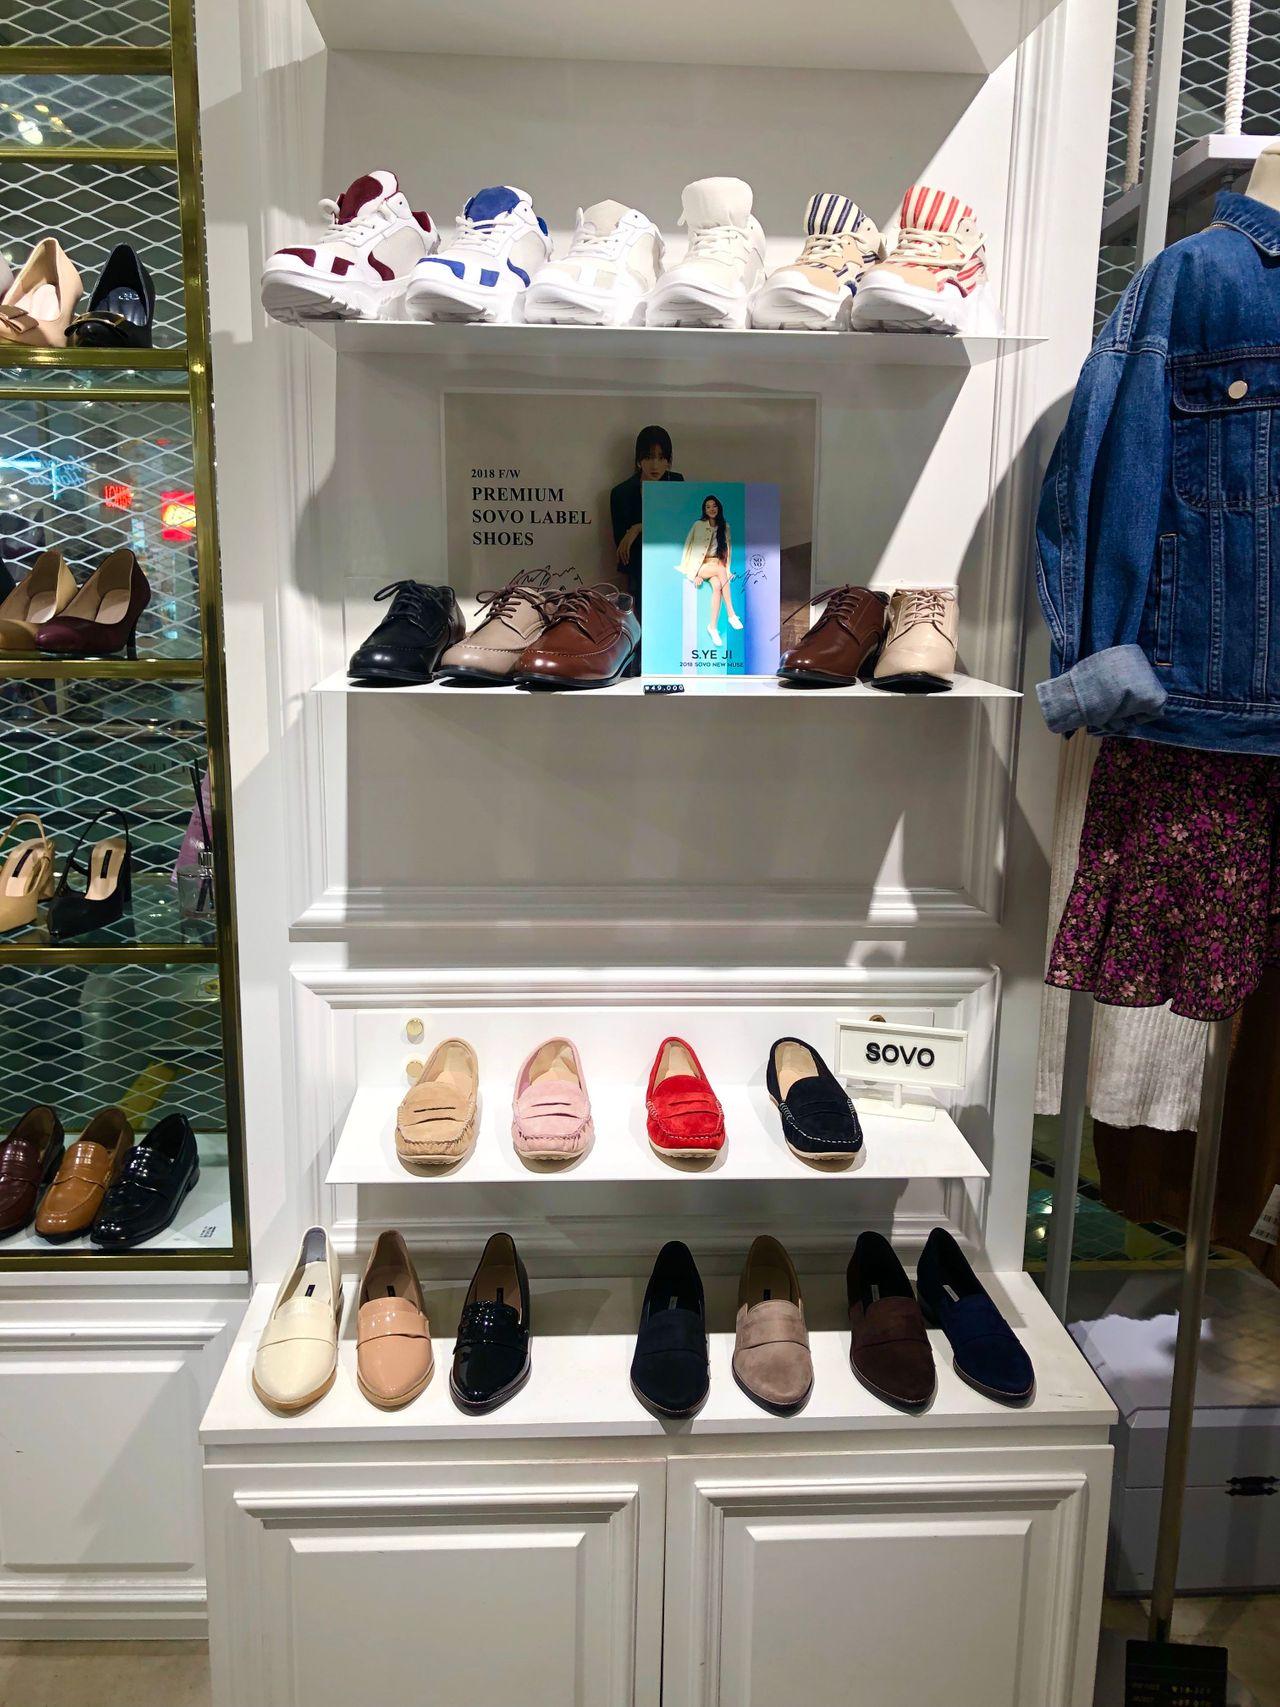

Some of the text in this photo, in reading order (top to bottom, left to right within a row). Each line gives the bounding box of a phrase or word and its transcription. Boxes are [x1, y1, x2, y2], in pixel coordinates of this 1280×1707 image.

[471, 469, 521, 478] 2018 F/W
[472, 487, 564, 502] PREMIUM
[472, 509, 592, 525] SOVO LABEL
[472, 531, 534, 546] SHOES
[721, 649, 733, 660] JI
[865, 1042, 935, 1067] SOVO
